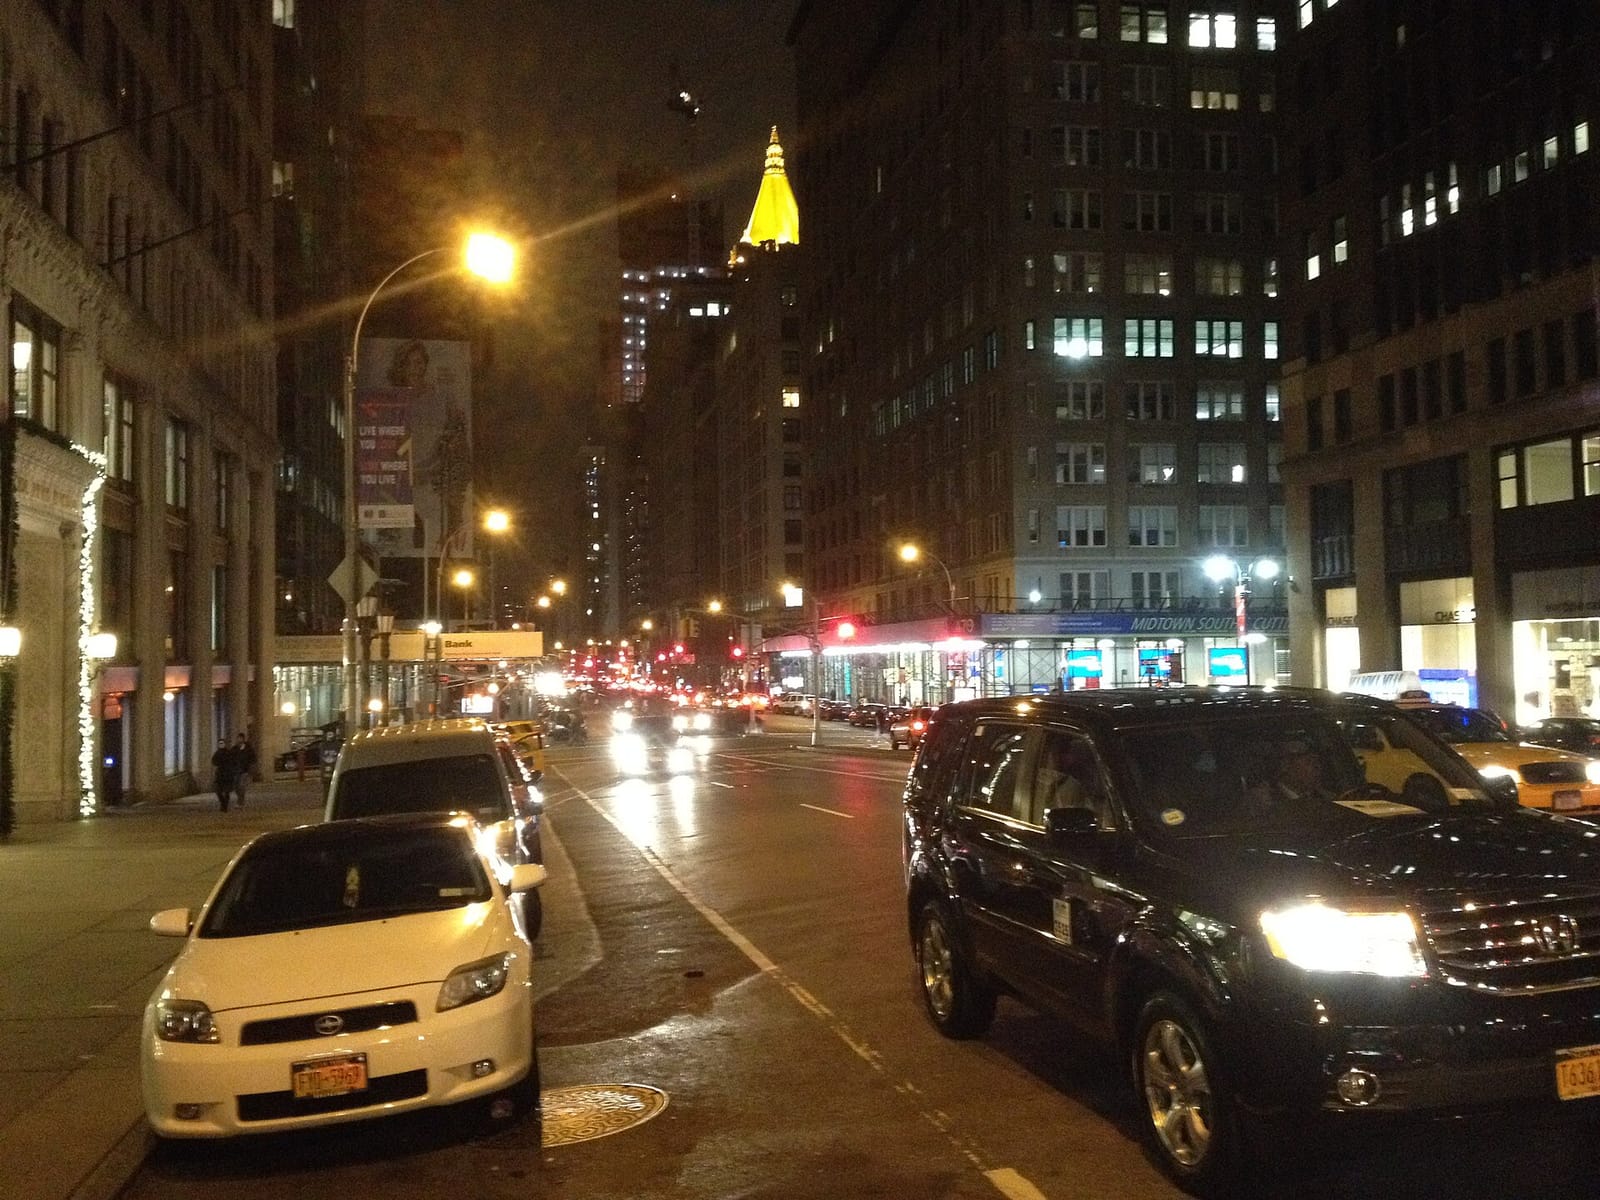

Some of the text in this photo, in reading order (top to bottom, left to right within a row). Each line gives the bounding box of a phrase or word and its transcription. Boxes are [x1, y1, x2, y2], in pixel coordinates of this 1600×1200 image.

[360, 439, 376, 449] YOU
[380, 461, 408, 471] WHERE
[1130, 617, 1195, 630] MIDTOWN
[445, 640, 473, 648] Bank
